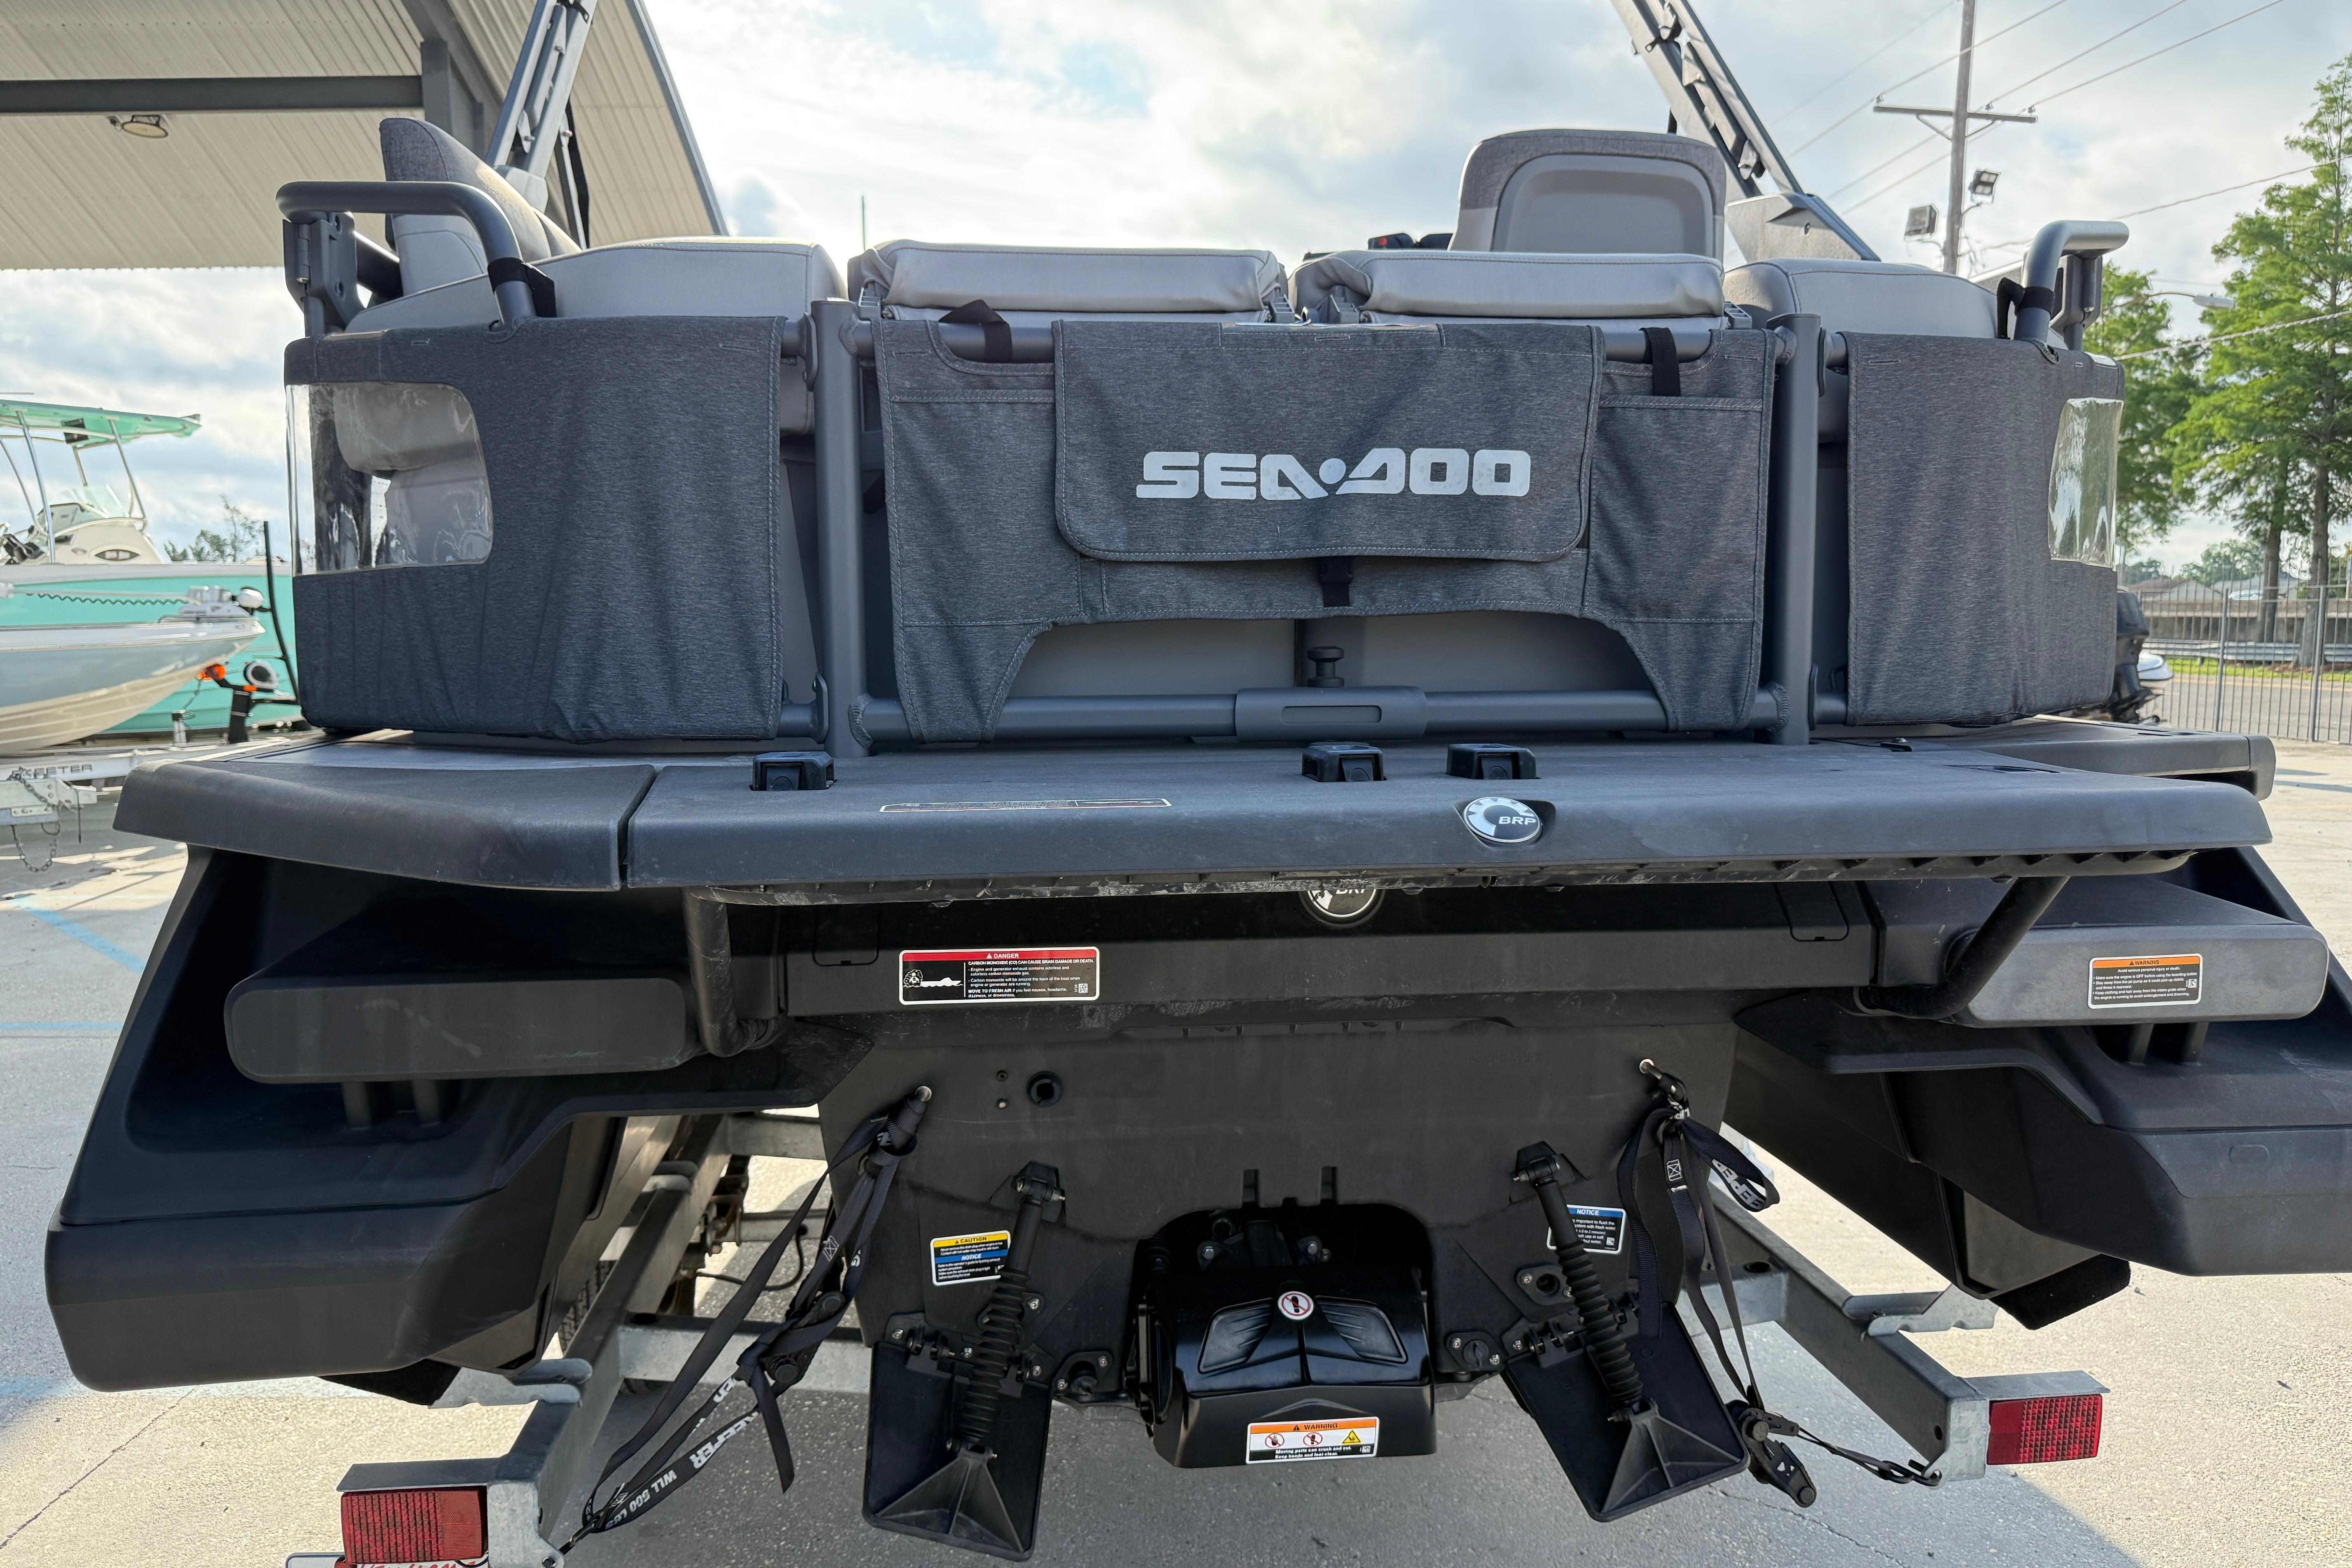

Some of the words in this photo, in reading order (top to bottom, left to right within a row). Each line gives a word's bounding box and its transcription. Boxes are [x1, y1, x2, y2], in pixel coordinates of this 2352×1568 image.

[1498, 816, 1536, 826] BRP
[1712, 1159, 1767, 1210] EEPER
[629, 1489, 651, 1512] 500
